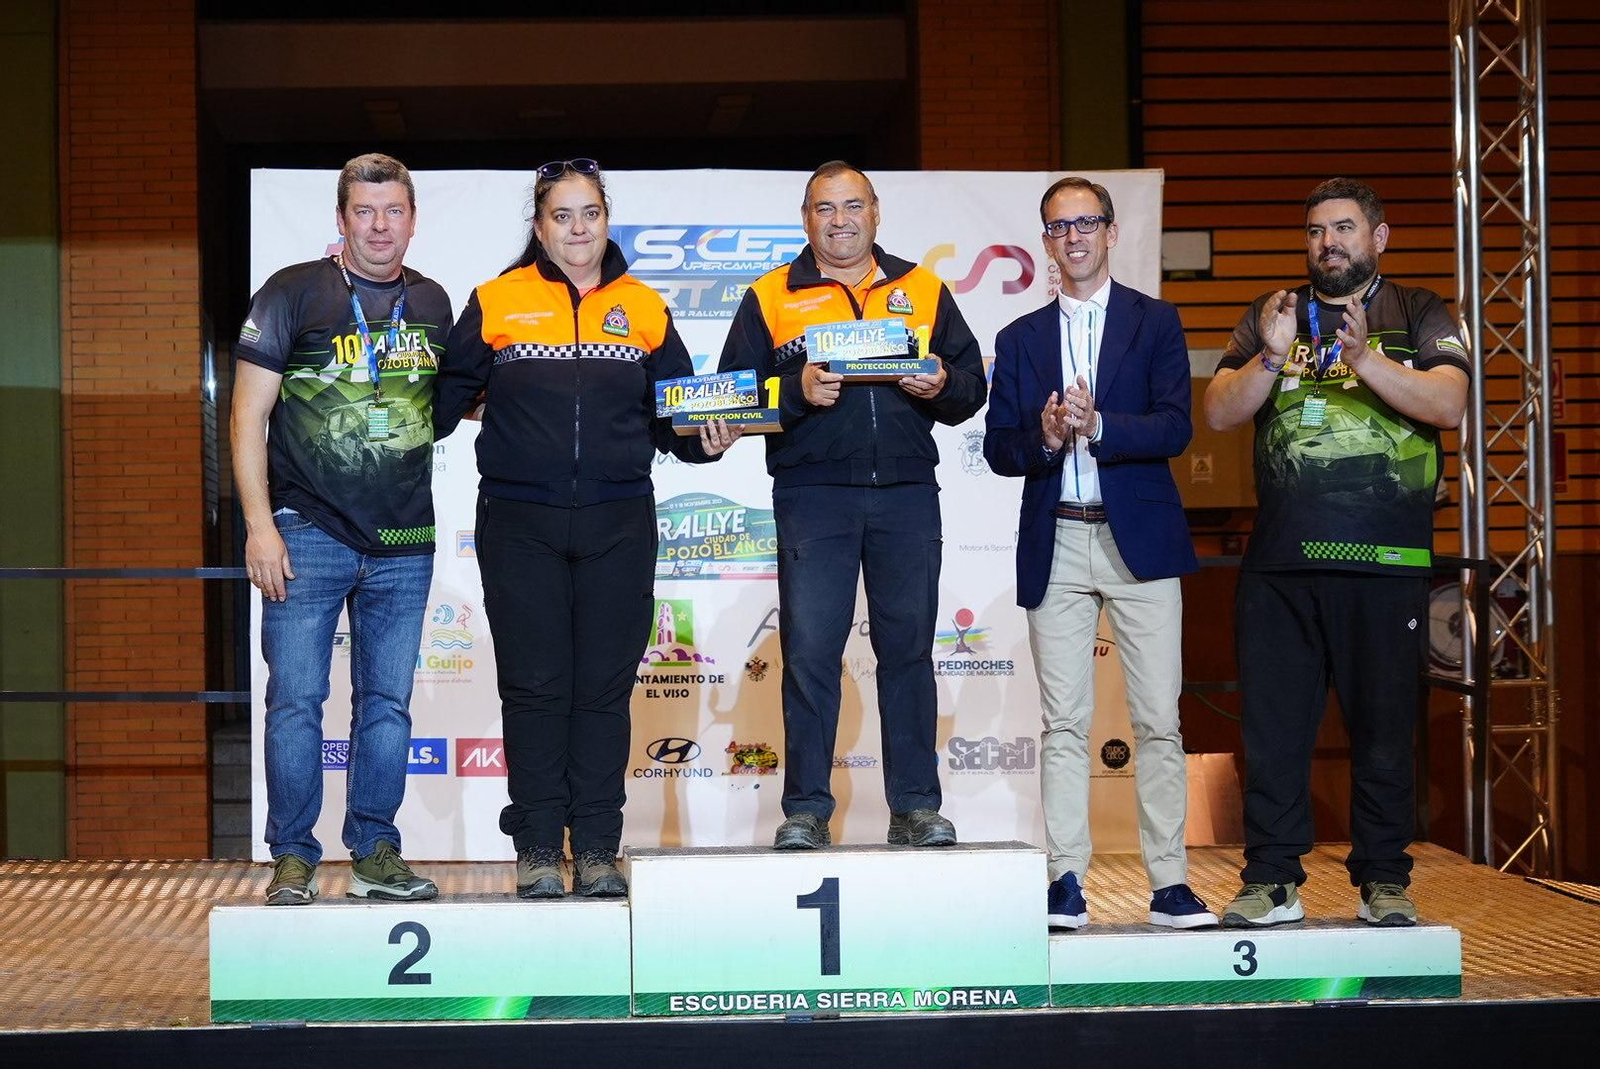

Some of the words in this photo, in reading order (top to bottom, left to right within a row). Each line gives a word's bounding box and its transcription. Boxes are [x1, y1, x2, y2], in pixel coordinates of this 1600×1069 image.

[332, 334, 359, 365] 10
[813, 331, 834, 353] 10
[835, 327, 886, 346] RALLYE
[846, 362, 899, 370] PROTECCION
[663, 386, 684, 407] 10
[684, 380, 736, 400] RALLYE
[764, 376, 781, 409] 1
[688, 413, 741, 421] PROTECCION
[658, 508, 747, 541] RALLYE
[666, 538, 778, 560] POZOBLANCO
[703, 534, 737, 544] CIUDAD
[740, 533, 751, 541] DE
[427, 654, 473, 674] Guijo
[938, 660, 1014, 670] PEDROCHES
[635, 674, 706, 684] NTAMIENTO
[709, 674, 725, 683] DE
[646, 689, 660, 698] EL
[663, 689, 690, 698] VISO
[633, 768, 713, 778] CORHYUND
[797, 877, 841, 976] 1
[388, 921, 432, 985] 2
[1233, 940, 1258, 976] 3
[670, 993, 809, 1012] ESCUDERIA
[816, 991, 906, 1009] SIERRA
[914, 989, 1018, 1007] MORENA
